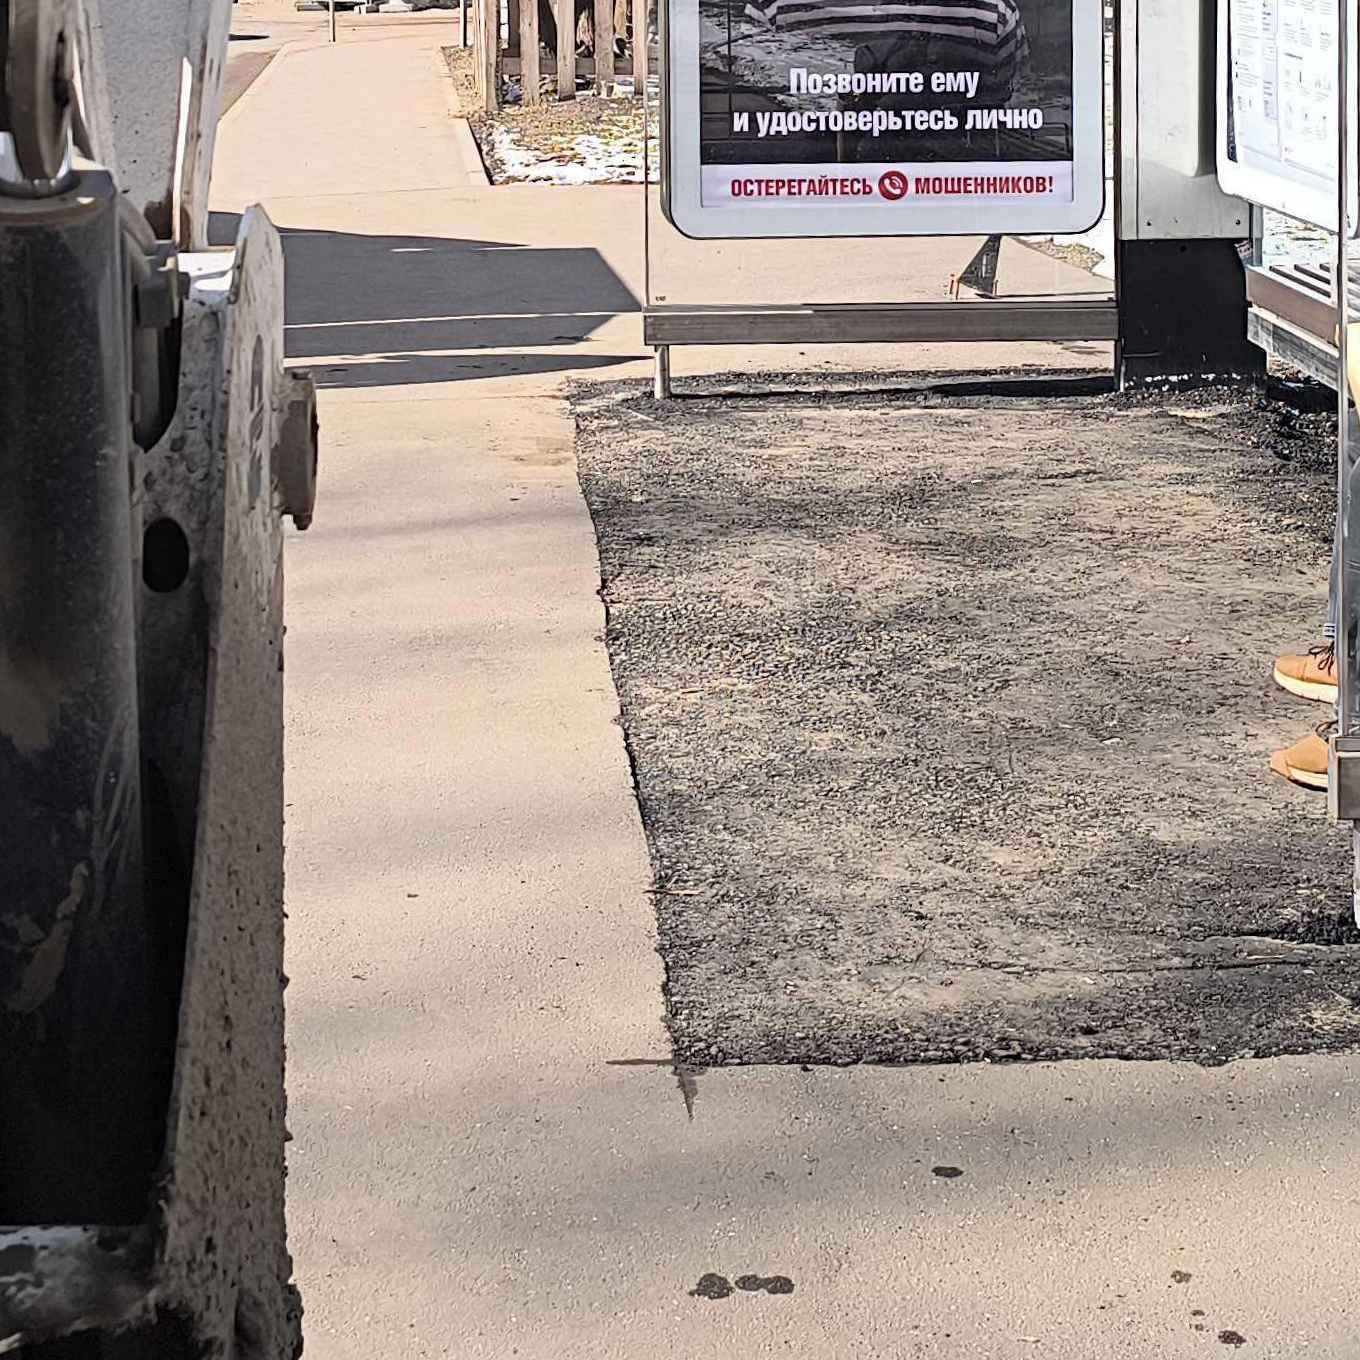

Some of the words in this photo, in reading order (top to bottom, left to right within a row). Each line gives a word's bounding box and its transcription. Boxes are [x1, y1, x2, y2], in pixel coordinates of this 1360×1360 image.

[789, 67, 924, 95] Позвоните
[931, 71, 980, 99] ему
[732, 111, 749, 133] и
[757, 108, 958, 138] удостоверьтесь
[964, 107, 1043, 130] лично
[730, 175, 873, 197] ОСТЕРЕГАЙТЕСЬ
[914, 175, 1053, 196] МОШЕННИКОВ!
